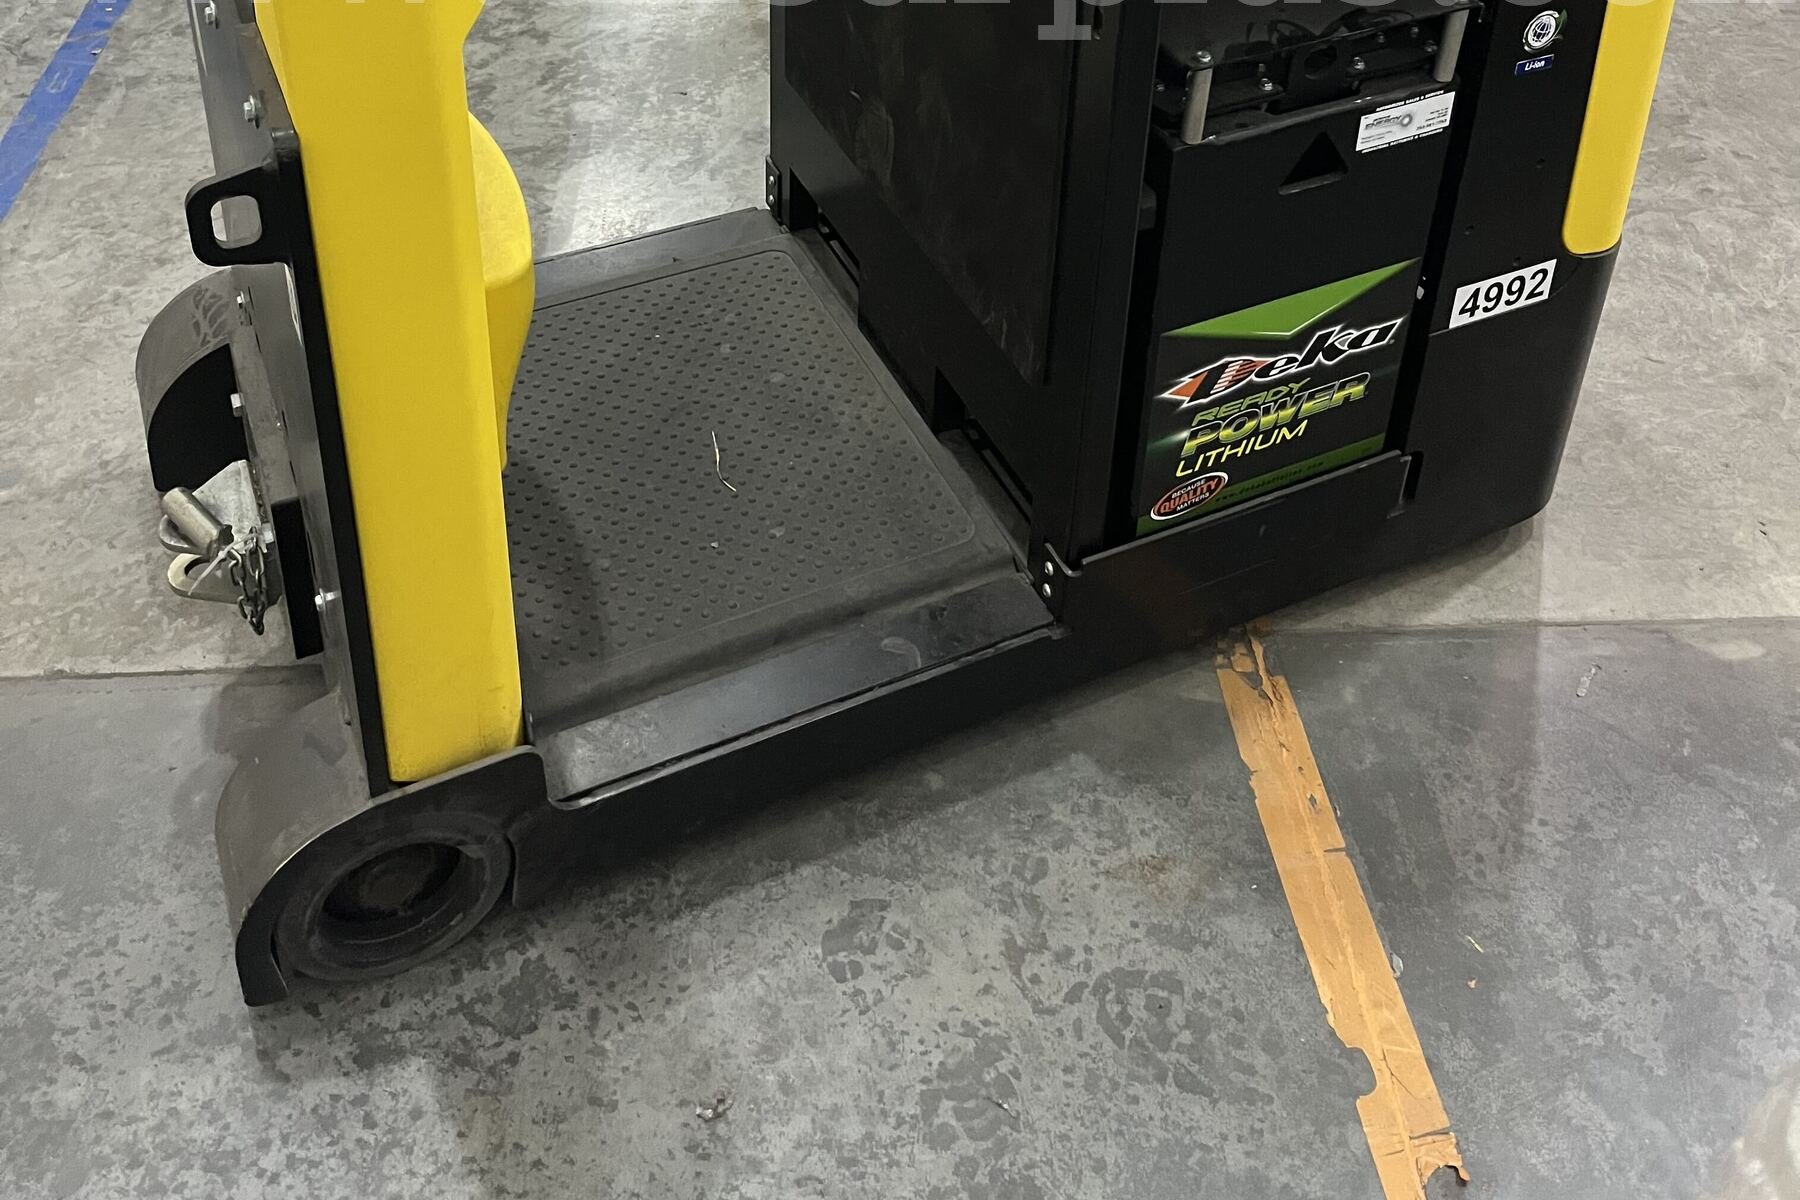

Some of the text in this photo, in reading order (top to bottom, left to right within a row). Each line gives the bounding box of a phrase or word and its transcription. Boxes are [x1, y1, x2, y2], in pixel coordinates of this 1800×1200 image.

[1458, 267, 1549, 319] 4992
[1158, 319, 1403, 408] Deka
[1181, 371, 1371, 458] POWER
[1191, 377, 1311, 426] READY
[1175, 419, 1308, 478] LITHIUM
[1160, 477, 1219, 514] QUALITY
[1171, 478, 1206, 499] BECAUSE
[1176, 491, 1210, 512] MATTERS
